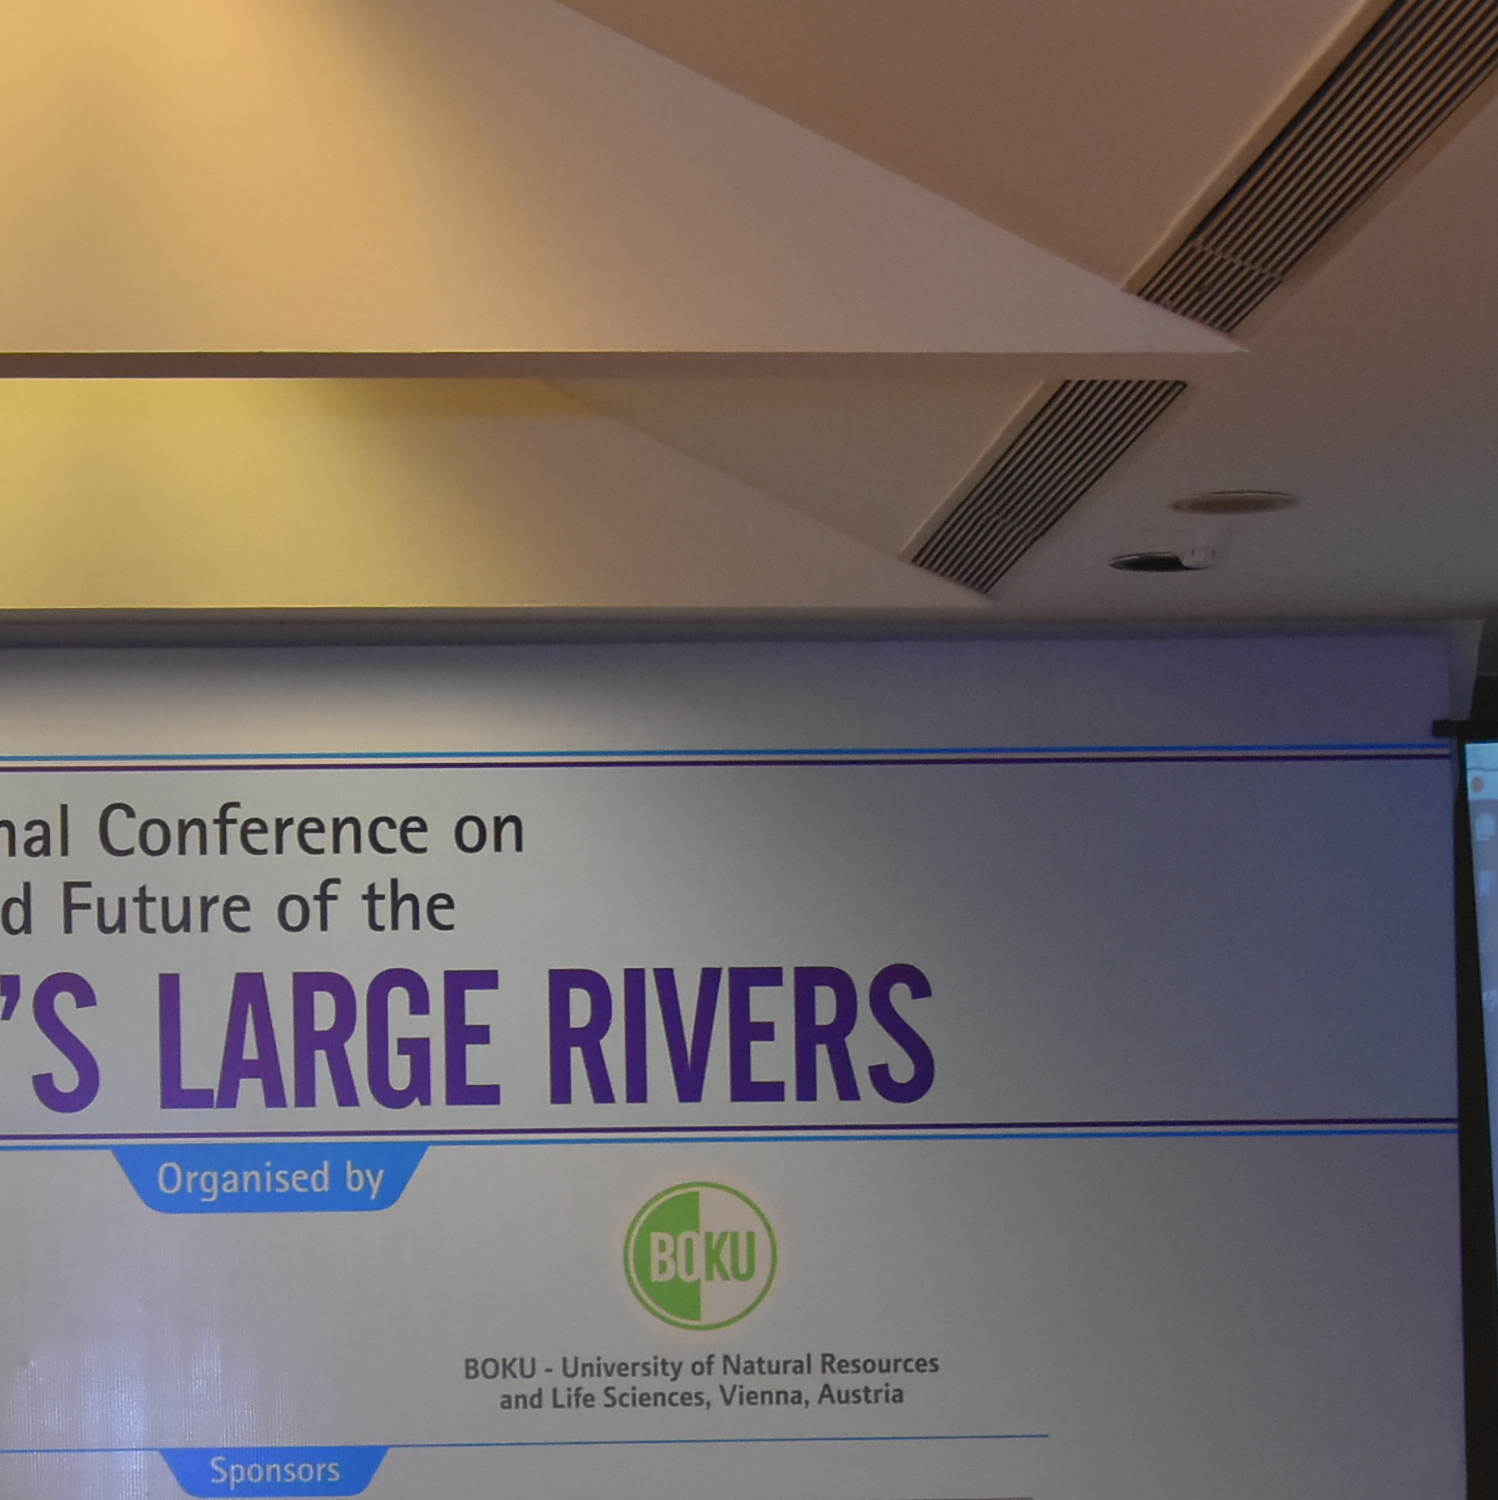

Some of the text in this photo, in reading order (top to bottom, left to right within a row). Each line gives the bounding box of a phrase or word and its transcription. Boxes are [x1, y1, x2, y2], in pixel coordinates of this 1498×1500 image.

[99, 801, 428, 858] Conference
[455, 815, 522, 854] on
[63, 880, 251, 935] Future
[278, 878, 341, 933] of
[362, 877, 454, 932] the
[159, 967, 501, 1110] LARGE
[549, 963, 935, 1105] RIVERS
[155, 1160, 386, 1208] Organised by
[649, 1230, 757, 1283] BOKU
[465, 1352, 939, 1383] BOKU - University of Natural Resources
[500, 1382, 903, 1411] and Life Sciences, Vienna, Austria
[209, 1455, 341, 1491] Sponsors
